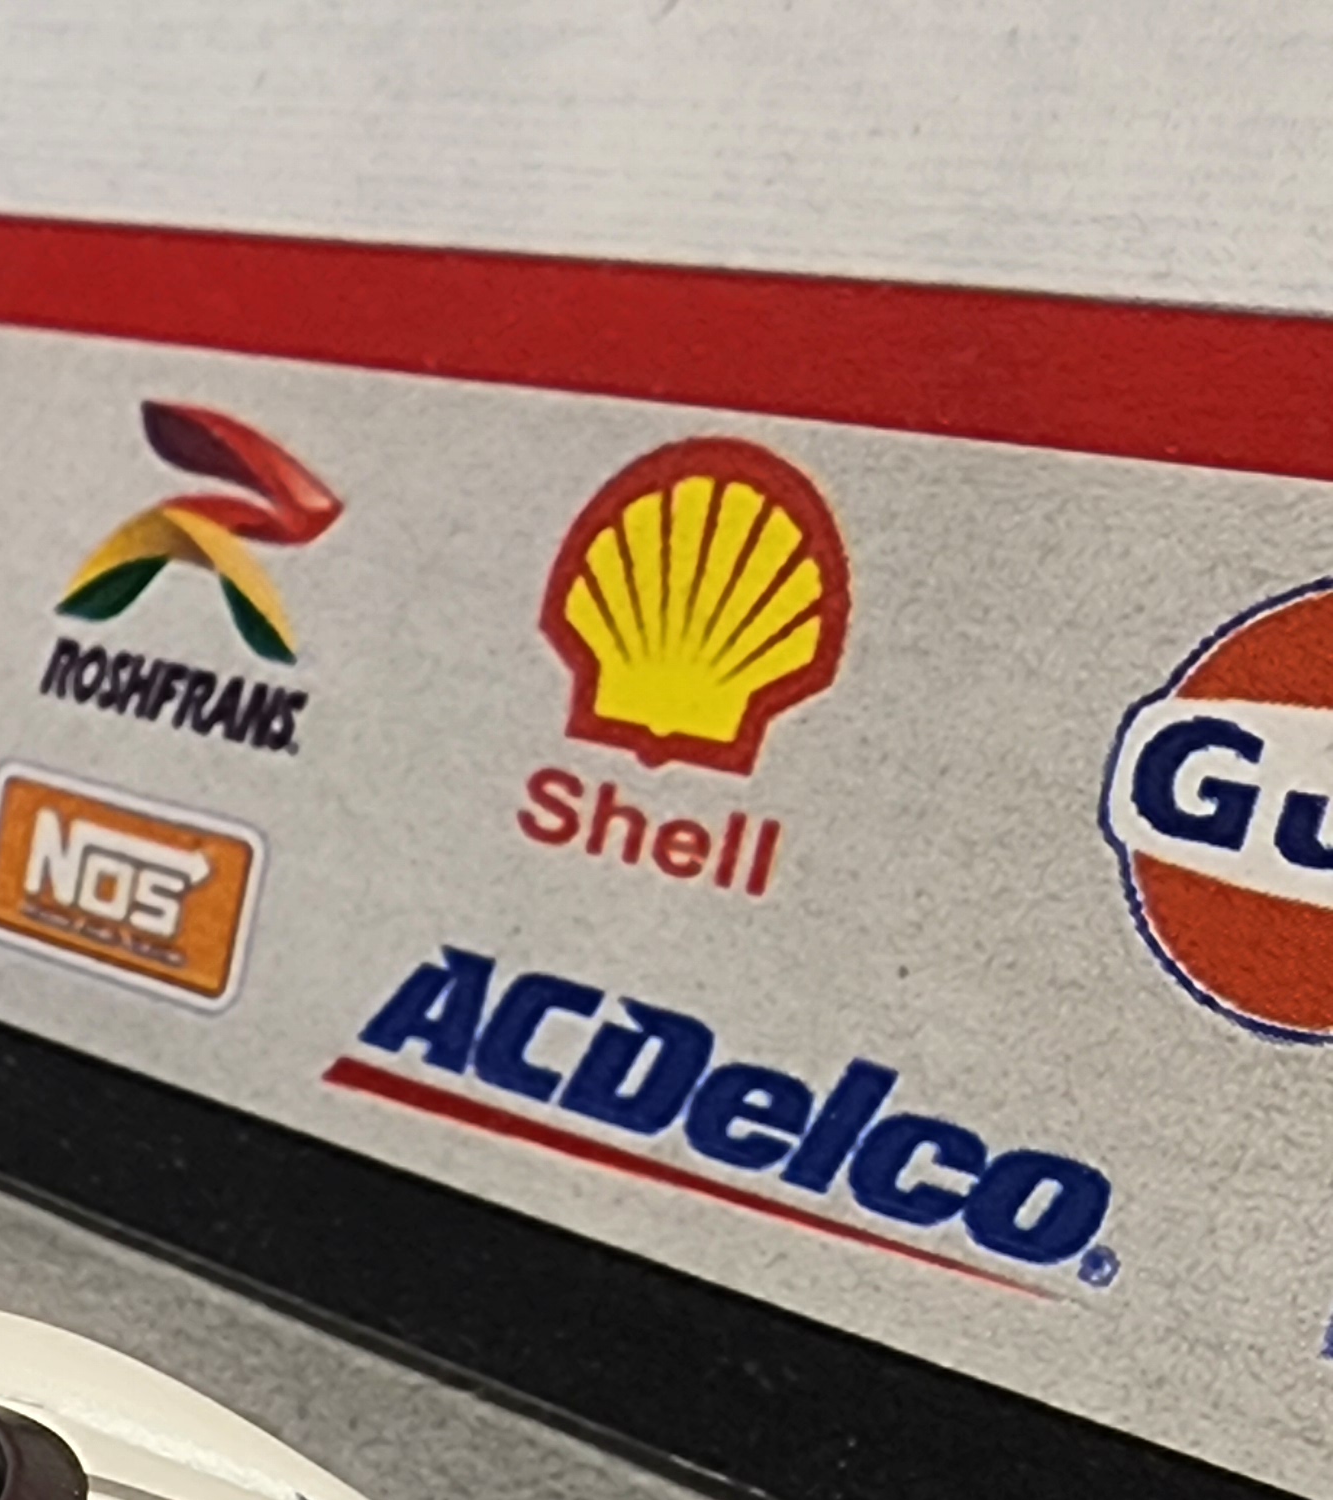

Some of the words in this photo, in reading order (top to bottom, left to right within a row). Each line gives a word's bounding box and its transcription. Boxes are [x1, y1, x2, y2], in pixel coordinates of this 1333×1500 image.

[39, 636, 309, 752] ROSHFRANS
[24, 806, 210, 937] NOS
[517, 767, 780, 896] Shell
[358, 944, 1112, 1264] ACDelco
